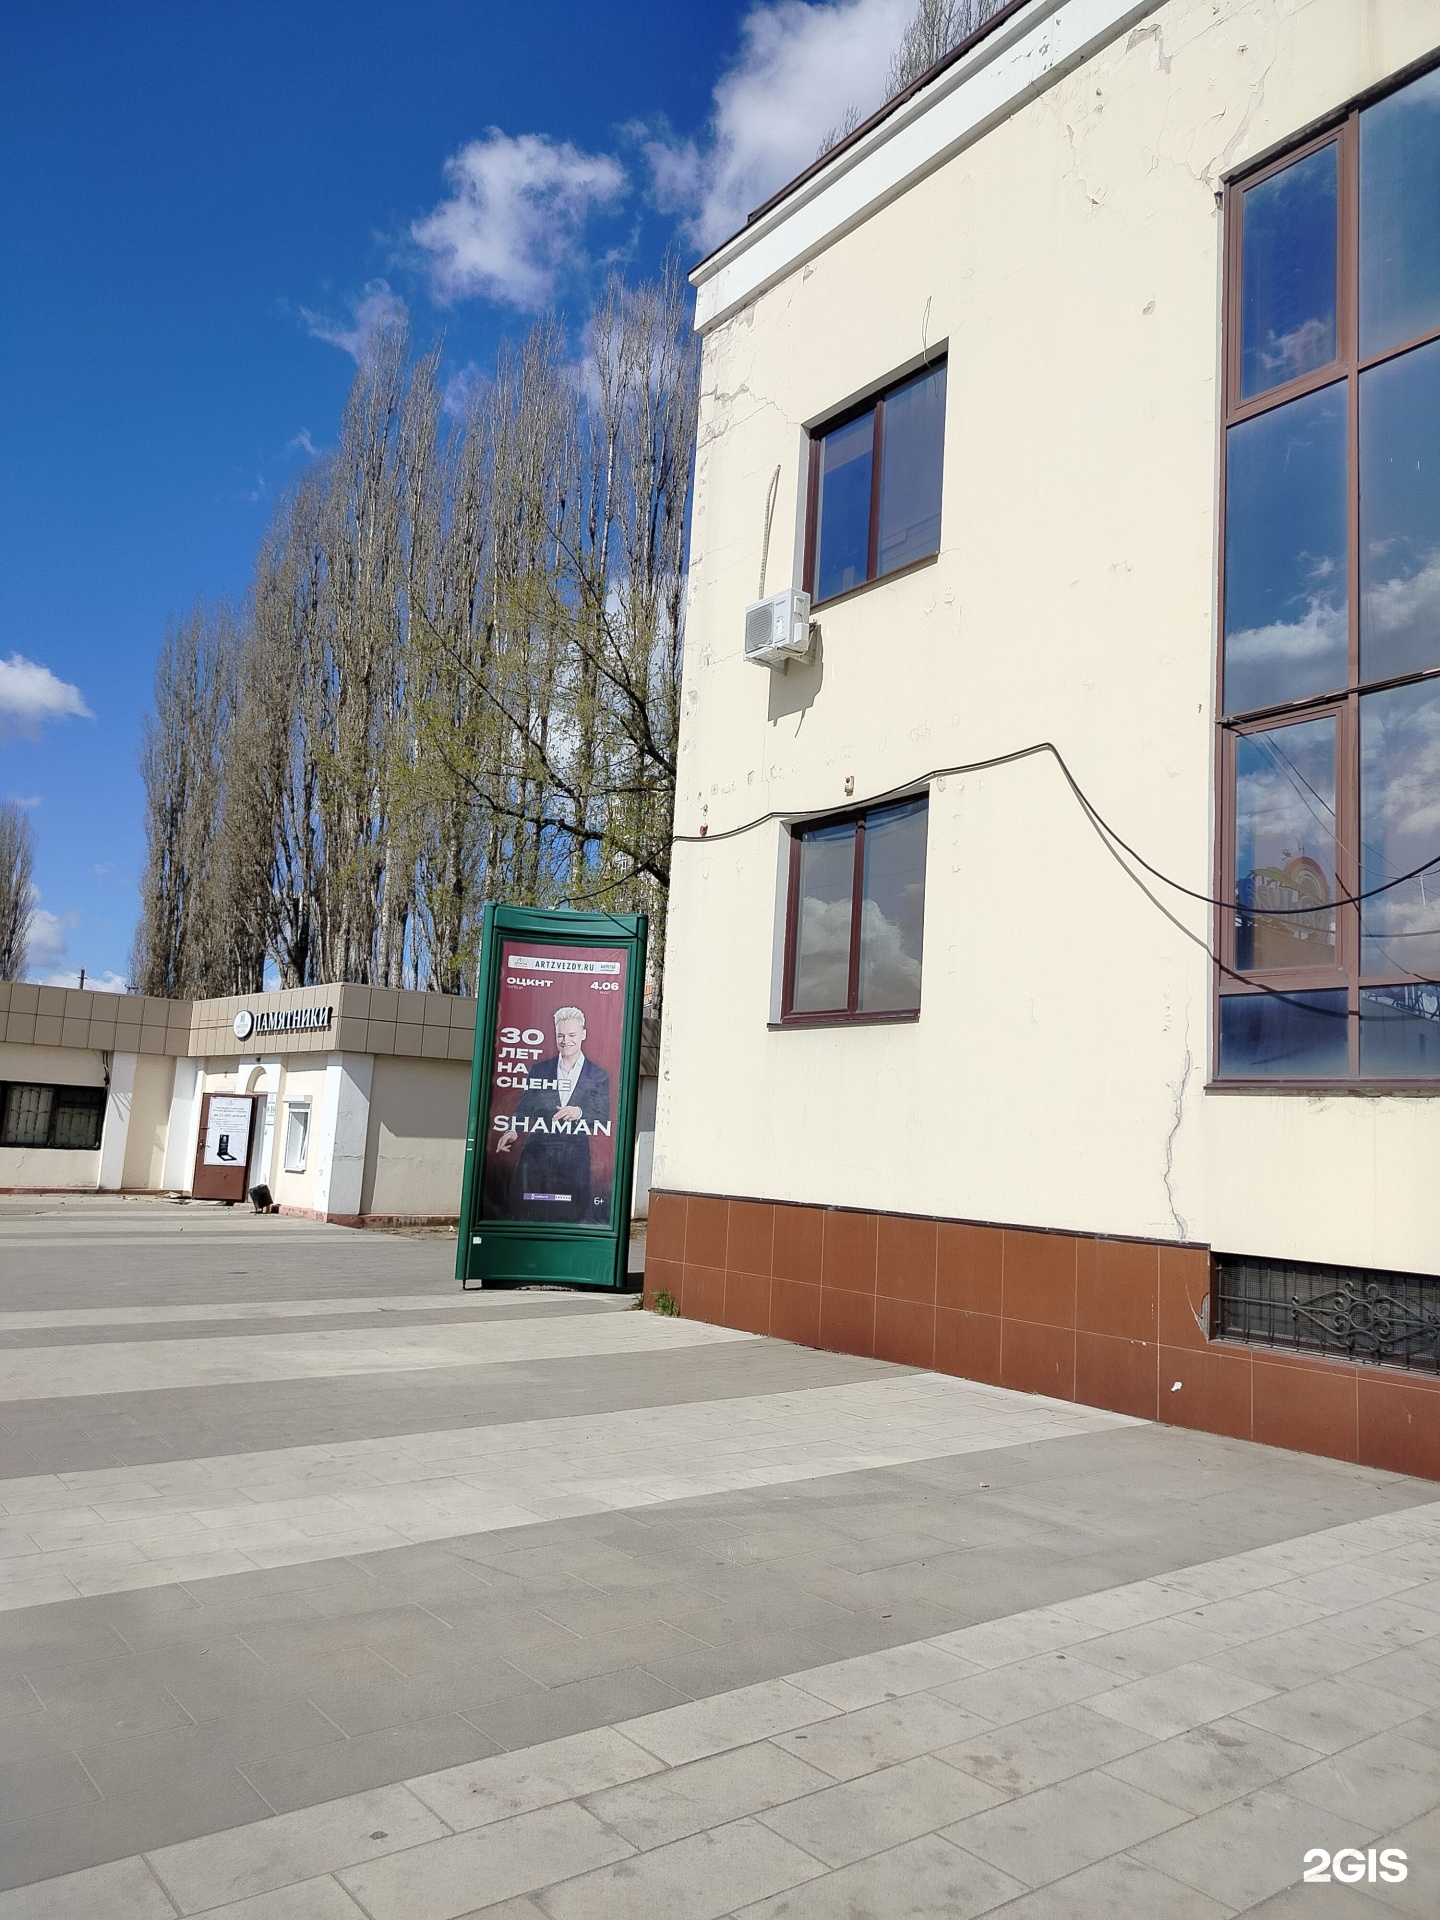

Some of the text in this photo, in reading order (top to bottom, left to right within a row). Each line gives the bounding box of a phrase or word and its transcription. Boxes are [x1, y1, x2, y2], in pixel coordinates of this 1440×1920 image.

[535, 960, 595, 972] ARTZVEZDY.RU
[506, 977, 554, 988] ОЦКНТ
[590, 981, 619, 991] 4.06
[254, 1006, 332, 1032] ПАМЯТНИКИ
[500, 1027, 545, 1045] 30
[498, 1047, 543, 1060] ЛЕТ
[497, 1061, 529, 1074] НА
[496, 1076, 571, 1091] СЦЕНЕ
[493, 1115, 612, 1136] SHAMAN
[593, 1196, 604, 1205] 6+
